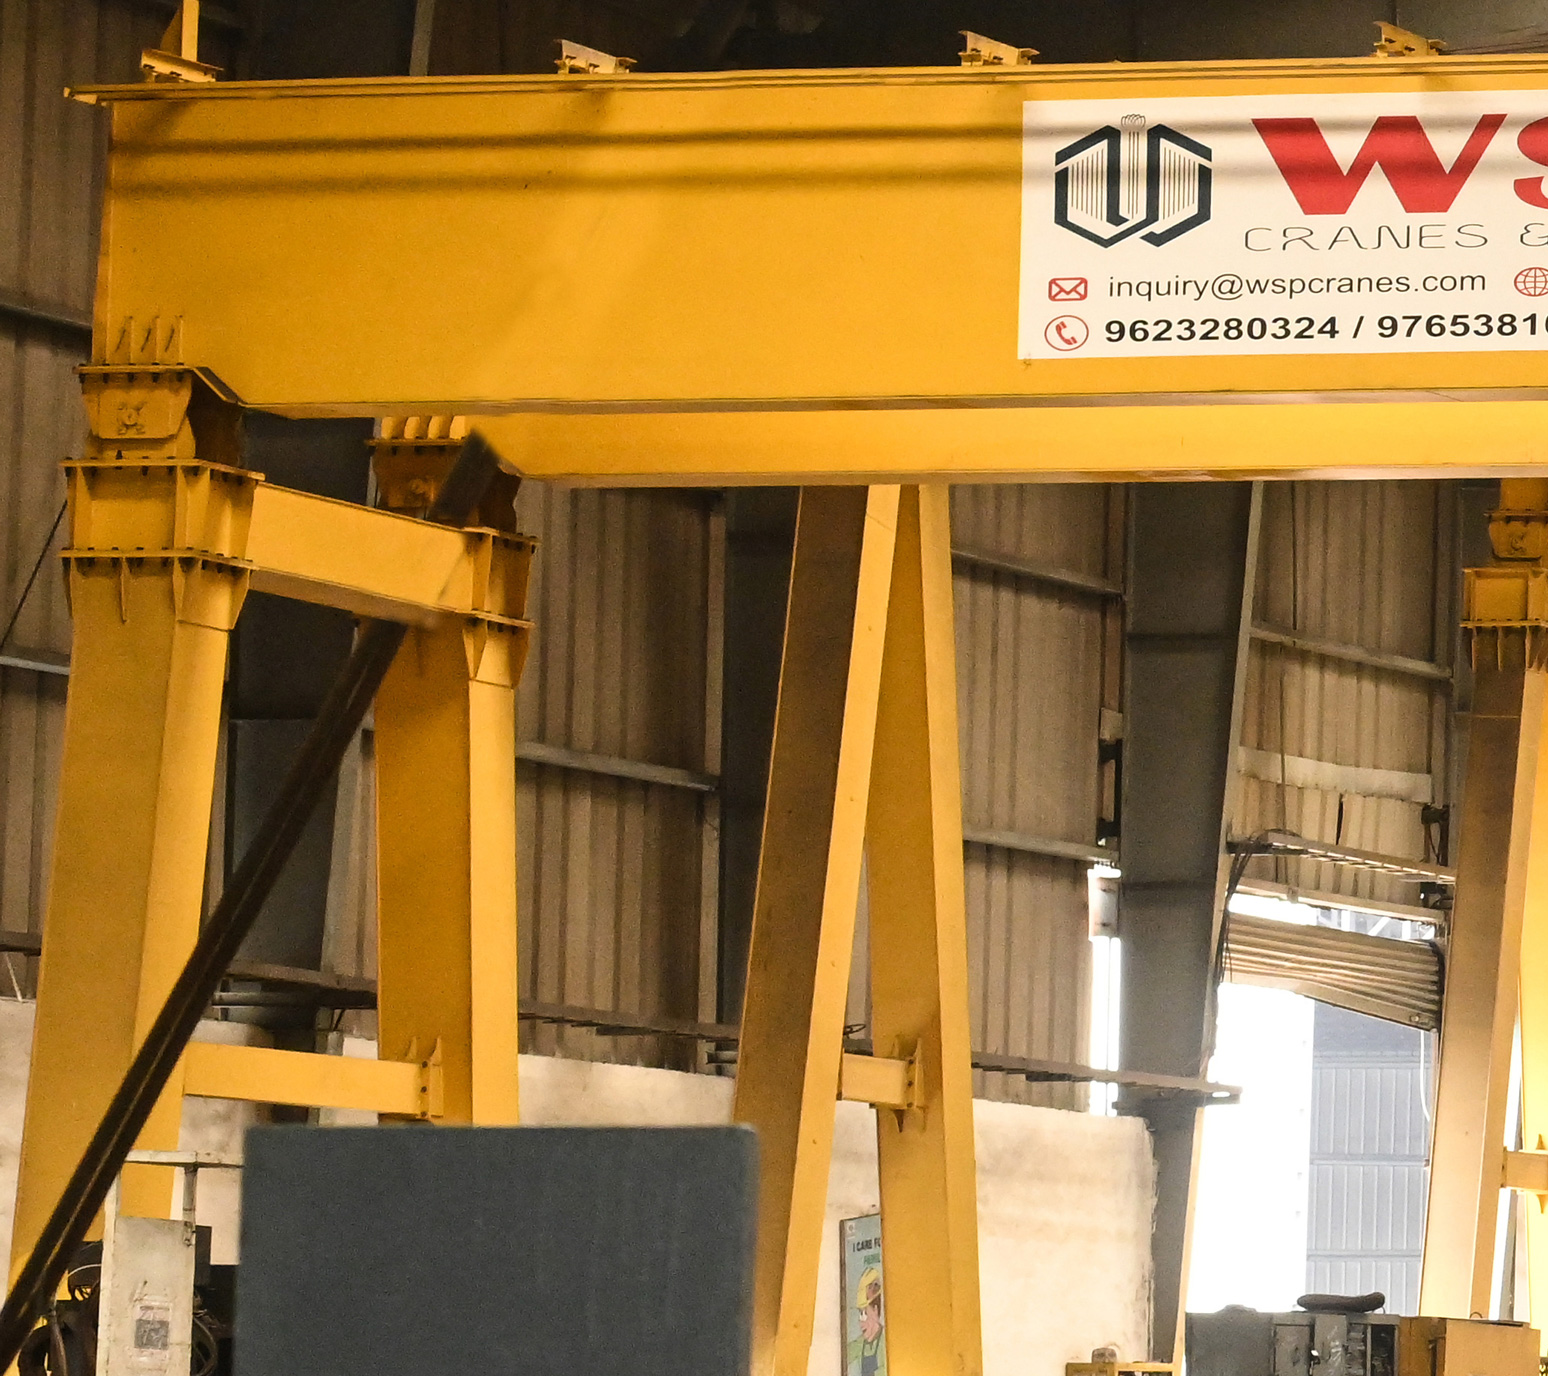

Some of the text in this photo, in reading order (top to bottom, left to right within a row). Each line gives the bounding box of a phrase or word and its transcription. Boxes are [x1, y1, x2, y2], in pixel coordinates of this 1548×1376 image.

[1244, 224, 1488, 252] CRANES
[1108, 273, 1486, 301] inquiry@wspcranes.com
[1104, 315, 1340, 343] 9623280324
[1352, 315, 1364, 339] /
